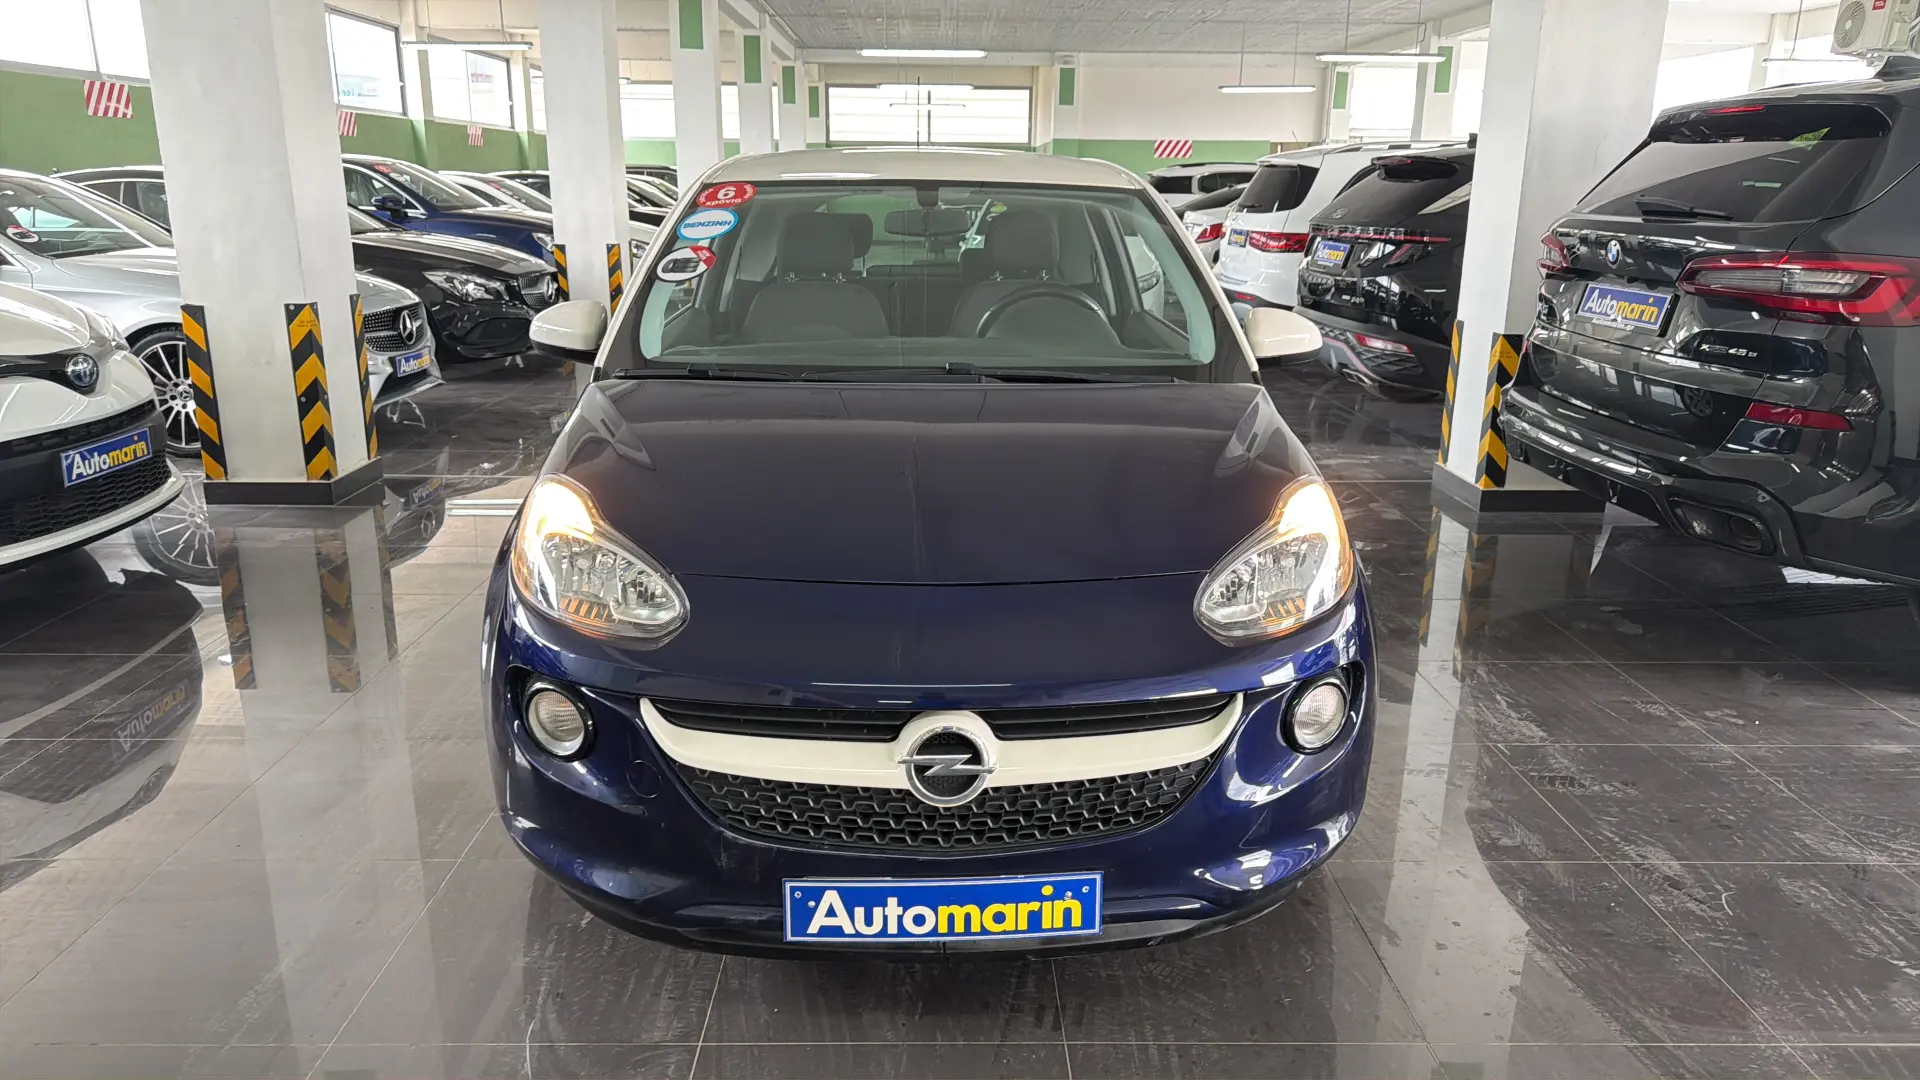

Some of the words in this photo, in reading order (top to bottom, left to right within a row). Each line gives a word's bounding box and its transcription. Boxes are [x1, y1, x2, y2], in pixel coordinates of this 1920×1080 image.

[717, 186, 736, 200] 6
[1584, 289, 1659, 323] Automarin
[72, 435, 148, 480] Automarin
[806, 884, 1082, 935] Automarin
